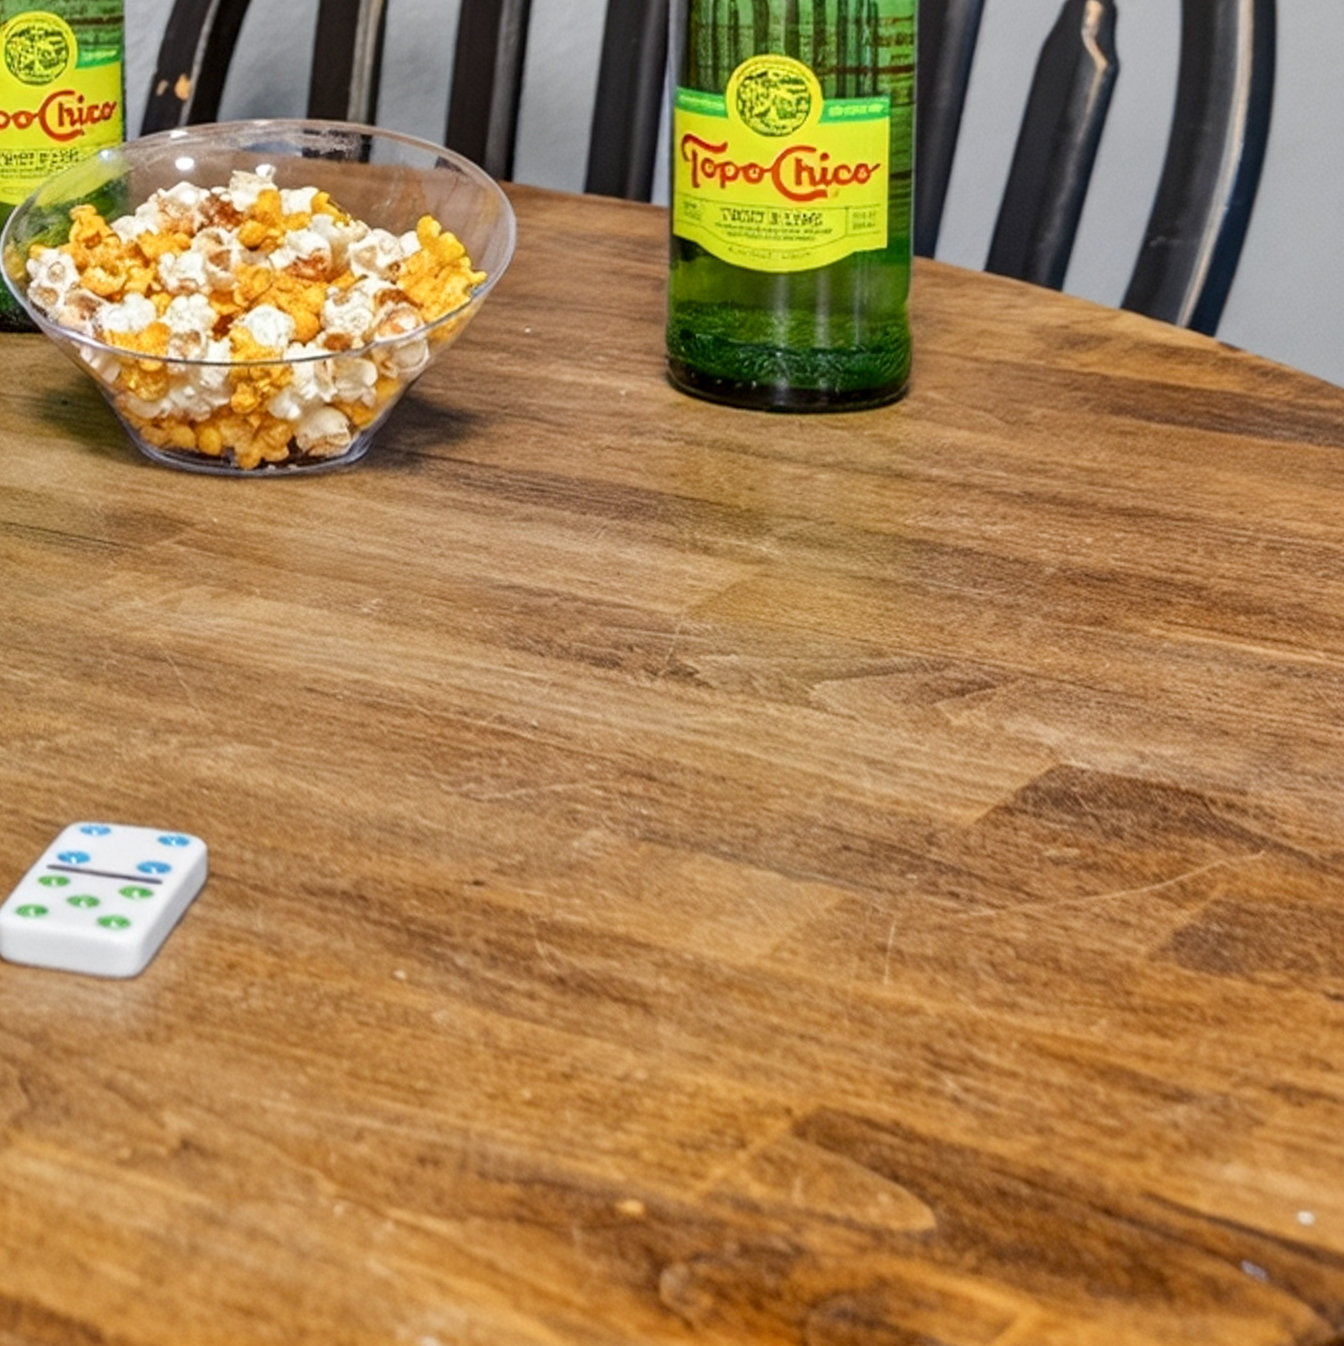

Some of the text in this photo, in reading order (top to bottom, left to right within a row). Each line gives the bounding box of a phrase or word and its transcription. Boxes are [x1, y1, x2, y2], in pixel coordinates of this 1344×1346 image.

[38, 89, 117, 142] Chico
[681, 134, 881, 202] Topo Chico
